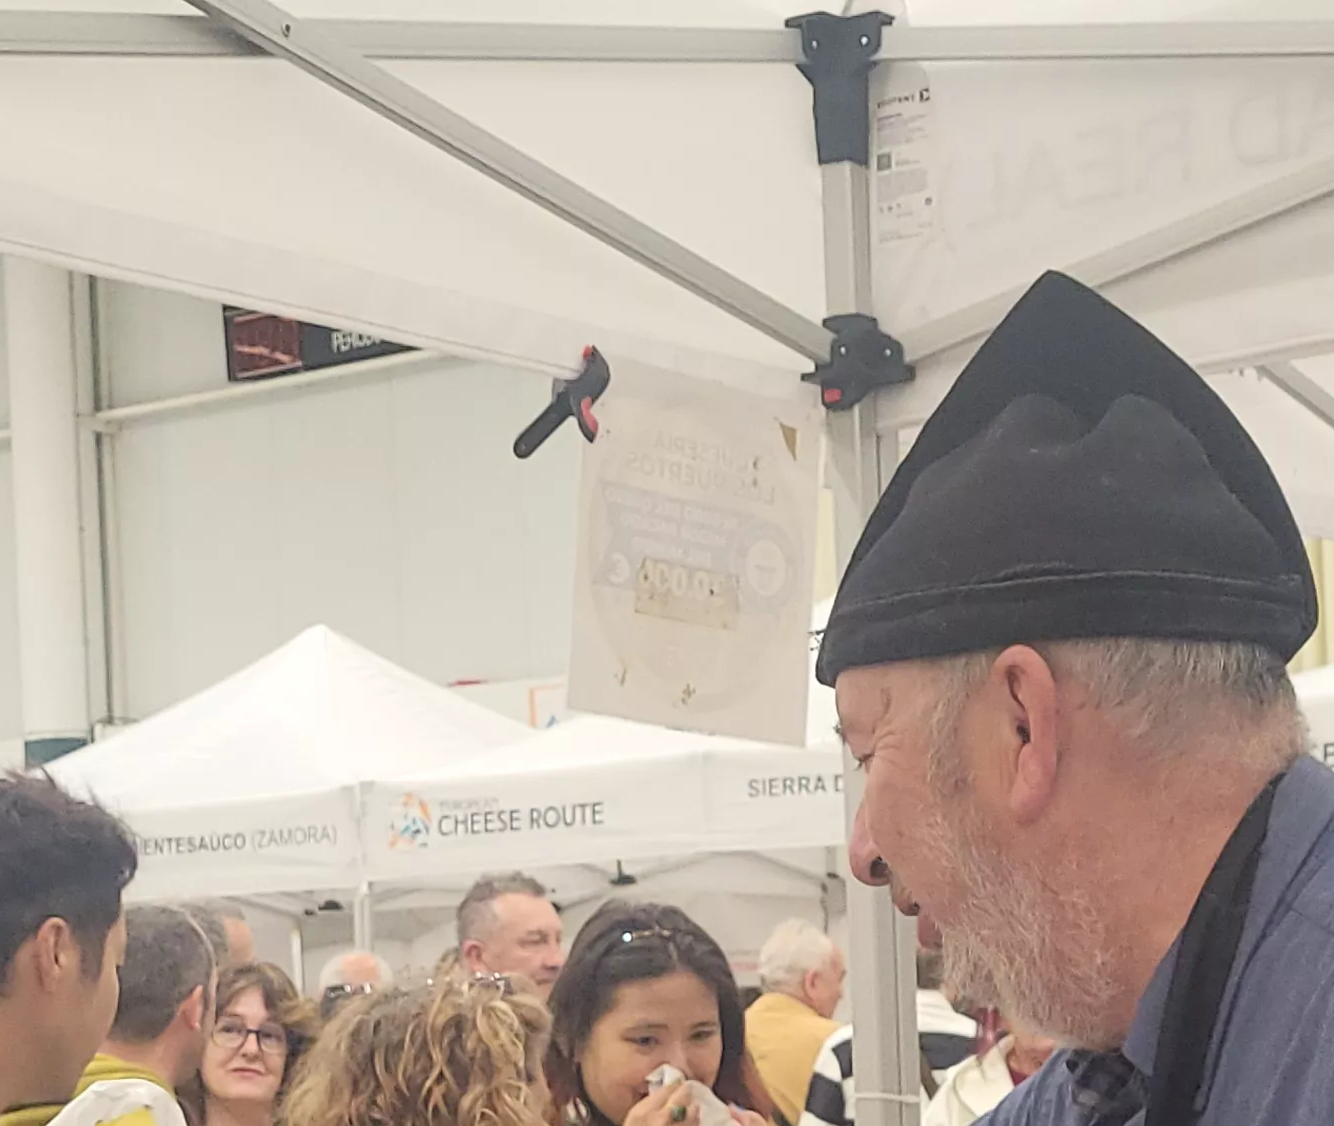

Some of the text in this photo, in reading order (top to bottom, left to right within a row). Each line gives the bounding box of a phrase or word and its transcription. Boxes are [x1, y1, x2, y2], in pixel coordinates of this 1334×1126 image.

[747, 775, 827, 798] SIERRA
[437, 802, 605, 837] CHEESE ROUTE
[141, 824, 338, 857] ENTESAÚCO (ZAMORA)
